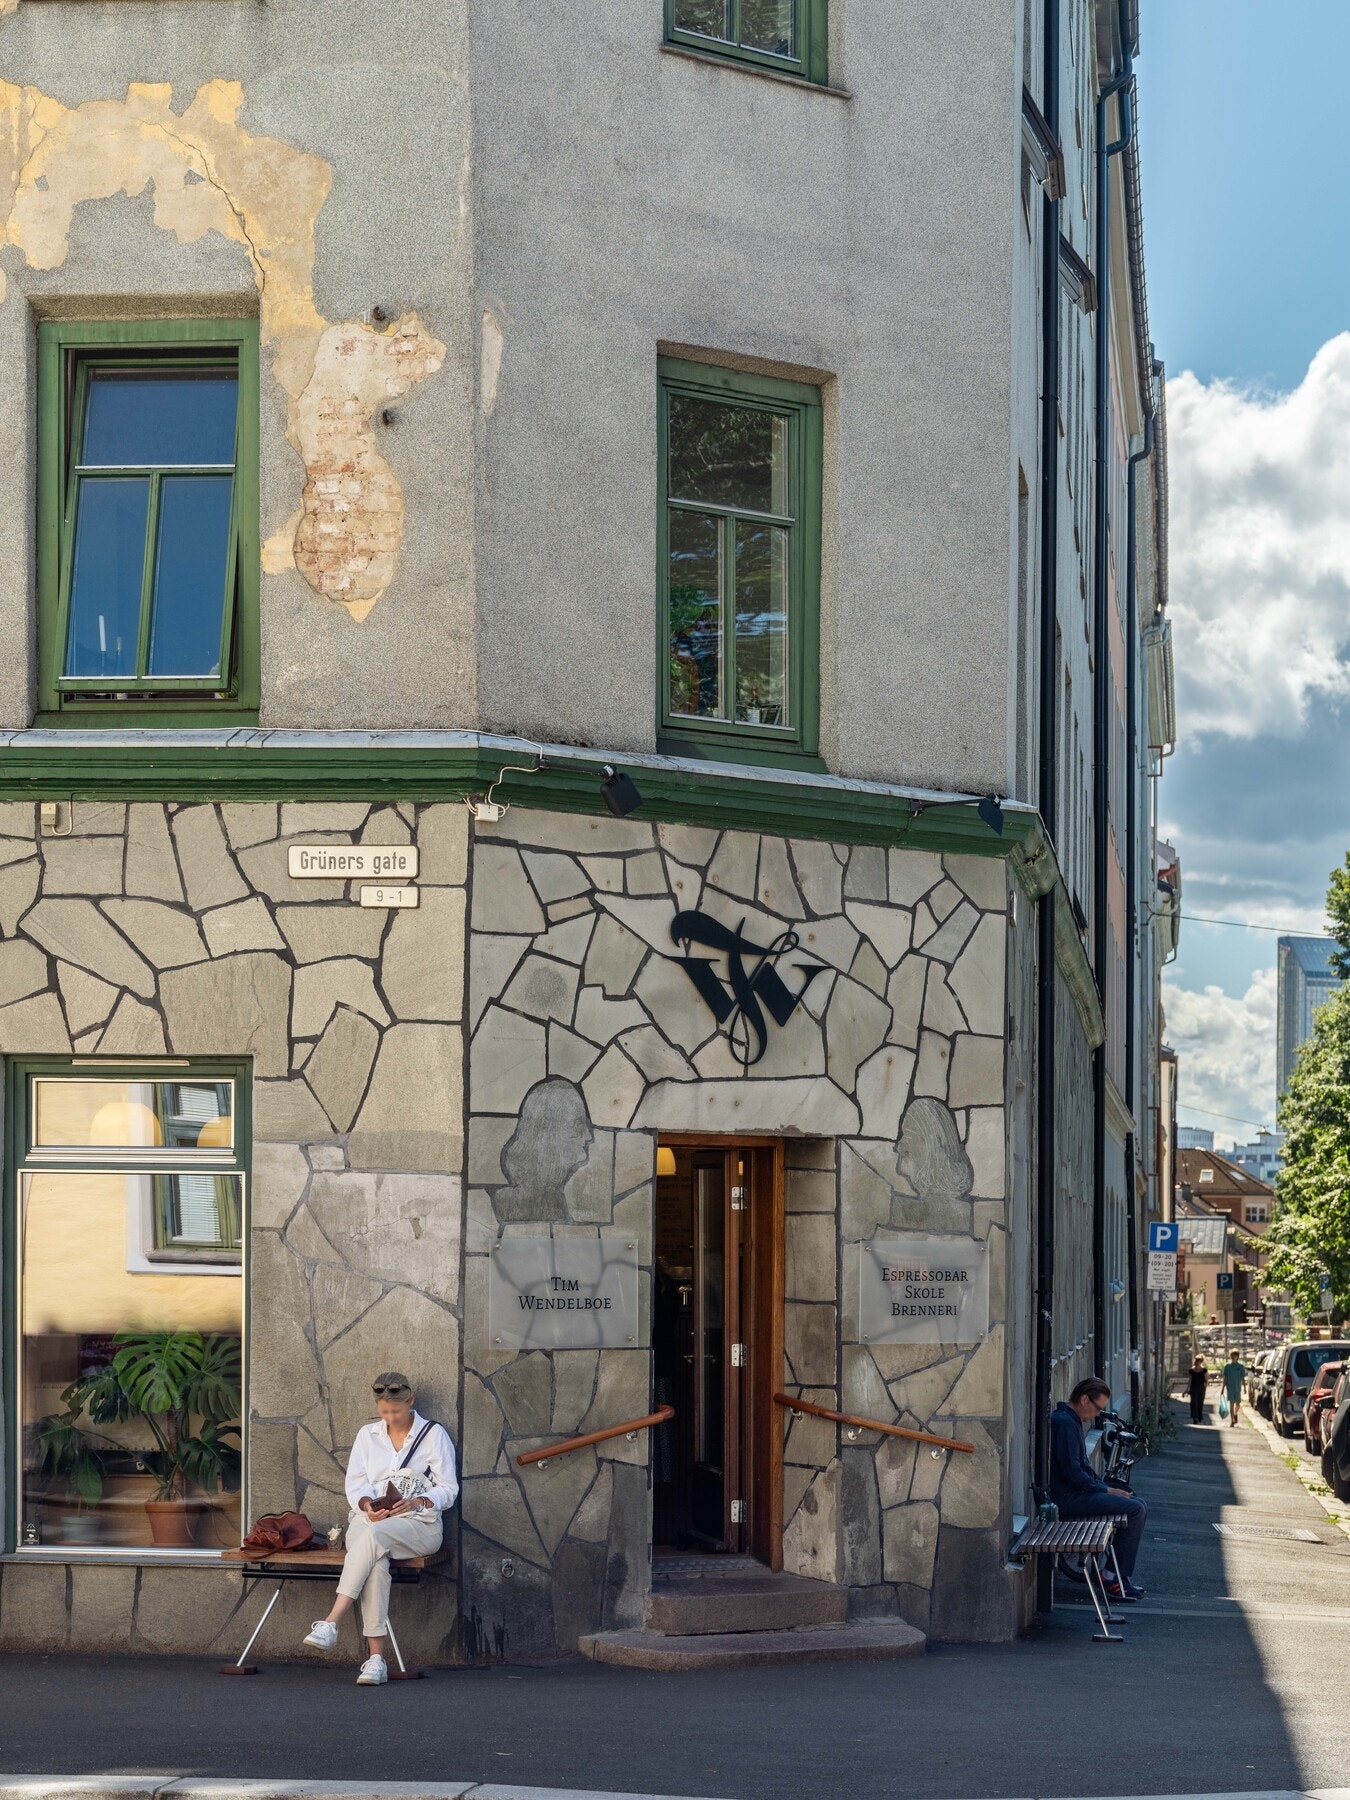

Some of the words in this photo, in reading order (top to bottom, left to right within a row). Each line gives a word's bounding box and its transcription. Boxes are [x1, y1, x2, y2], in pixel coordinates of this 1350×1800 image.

[300, 850, 364, 870] Grüners
[373, 851, 407, 875] gate
[1155, 1226, 1172, 1249] P
[1220, 1275, 1229, 1288] P
